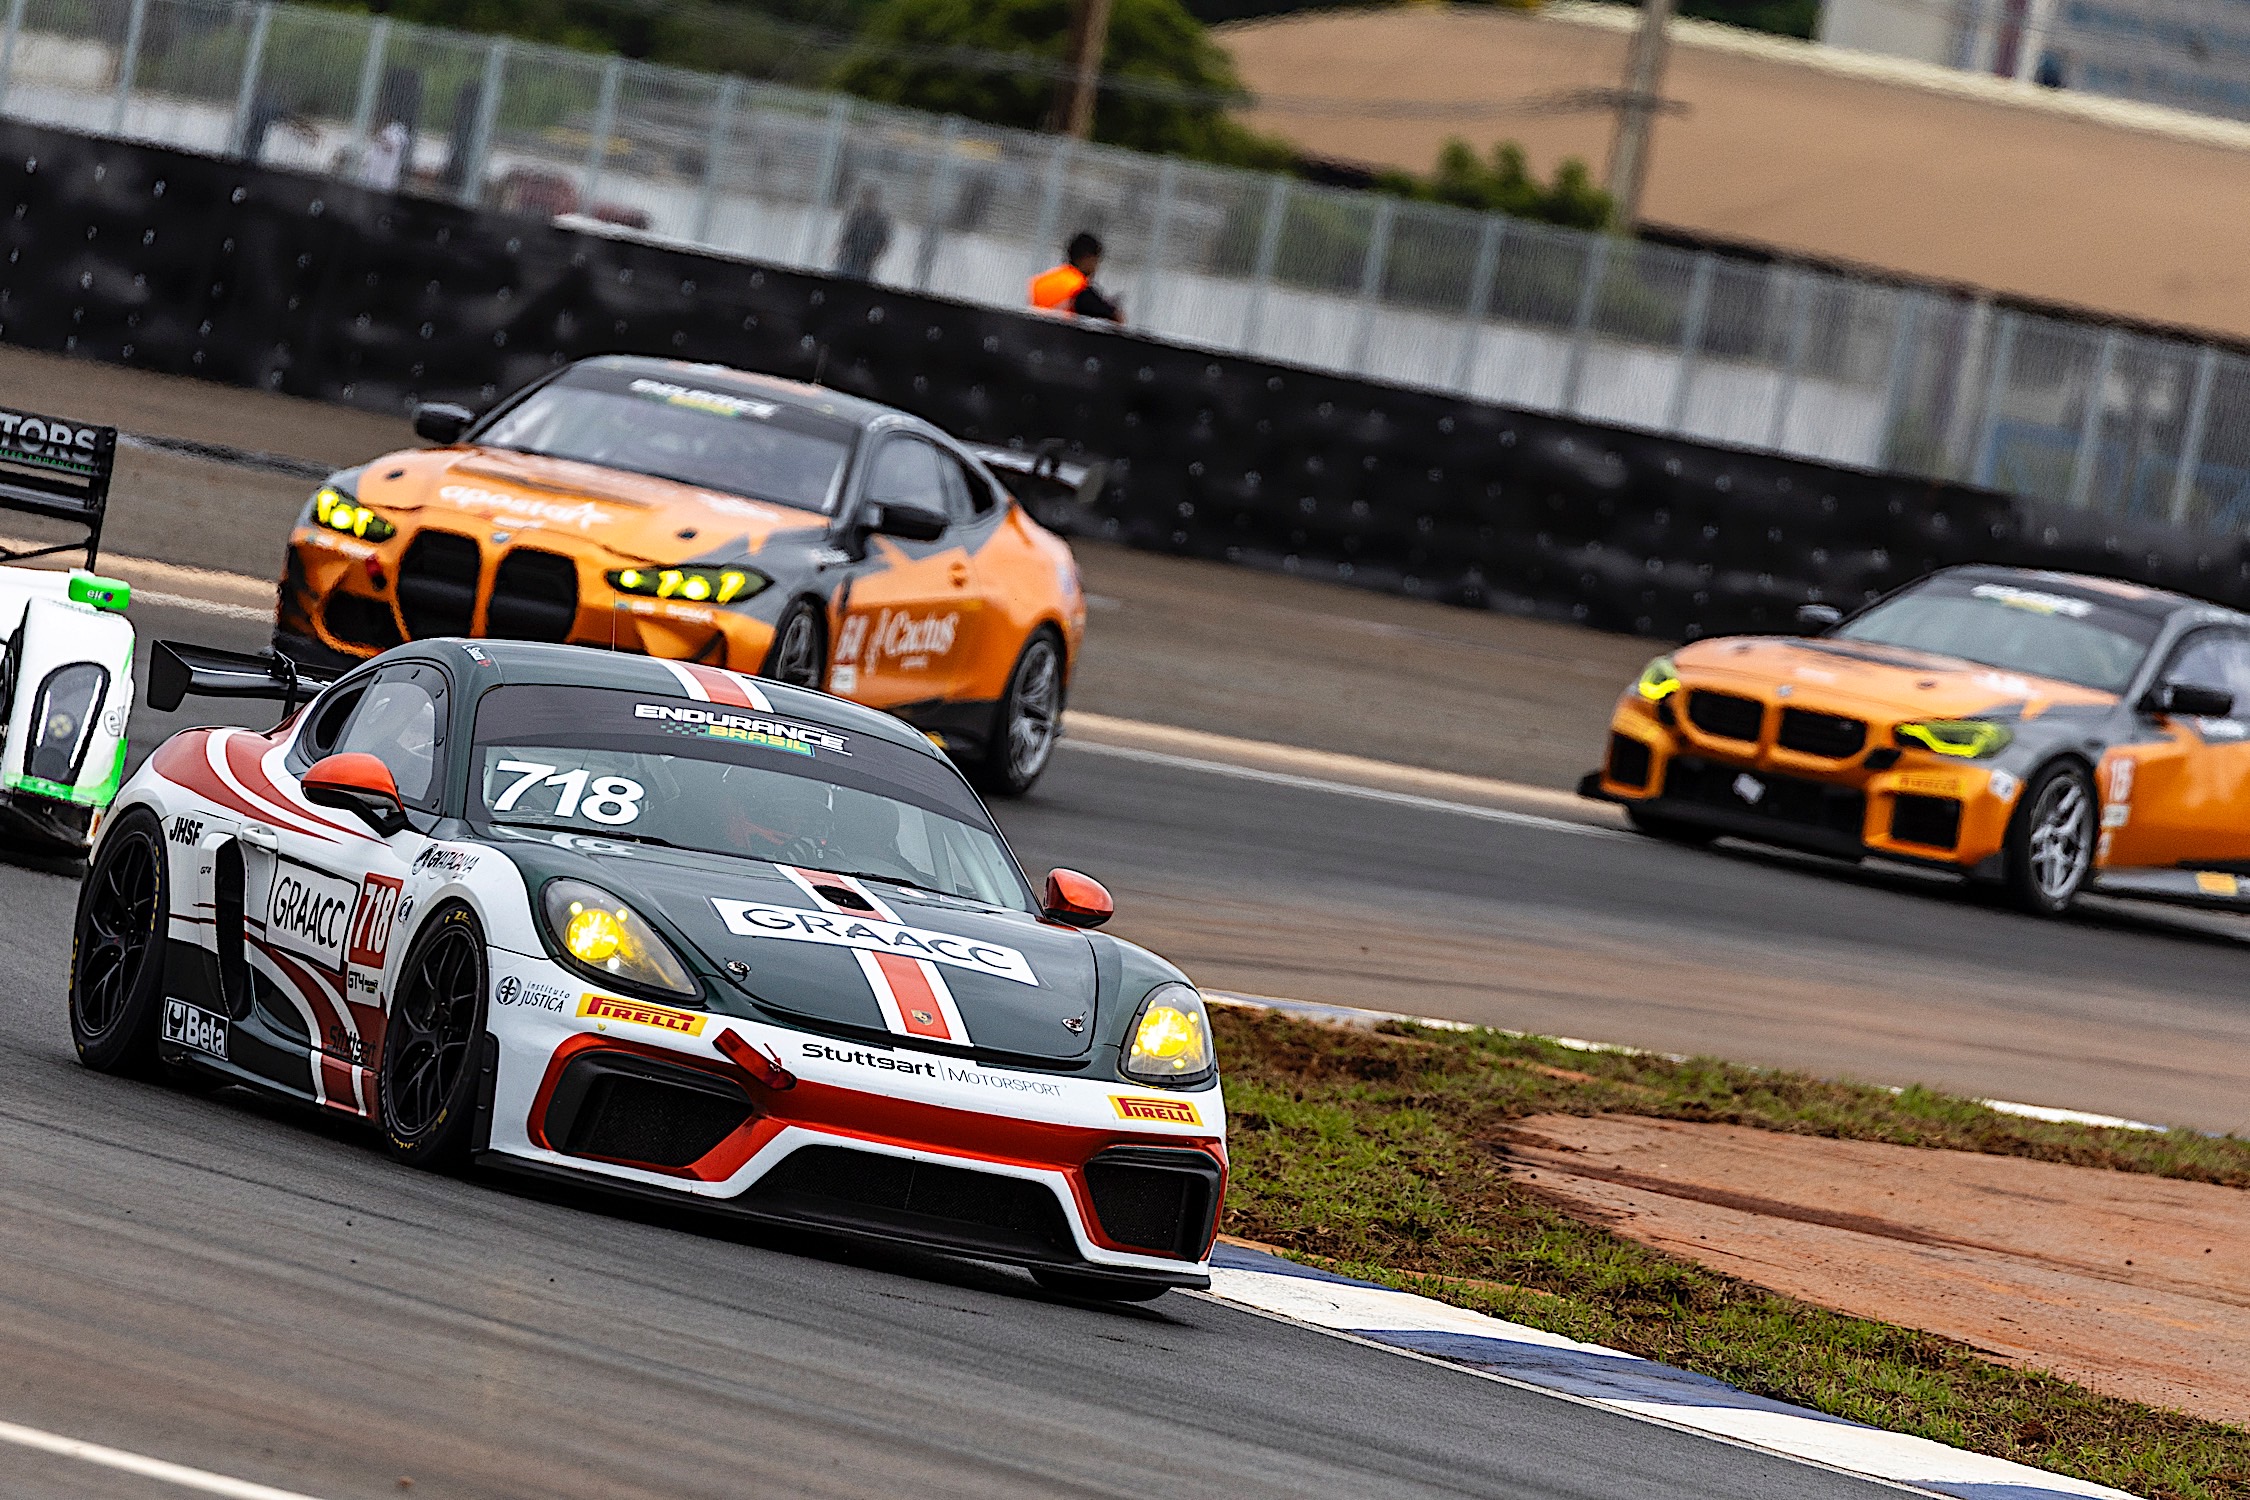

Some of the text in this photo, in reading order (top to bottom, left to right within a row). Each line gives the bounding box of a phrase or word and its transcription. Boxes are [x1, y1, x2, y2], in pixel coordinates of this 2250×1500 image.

[634, 704, 844, 751] ENDURANCE
[709, 725, 808, 752] BRASIL
[493, 759, 645, 825] 718
[169, 817, 203, 847] JHSF
[273, 876, 346, 949] GRAACC
[353, 882, 397, 954] 718
[743, 908, 1012, 970] GRAACC
[527, 981, 571, 999] instituto
[587, 996, 696, 1032] PIRELLI
[186, 1006, 226, 1057] Beta
[801, 1042, 1061, 1098] Stuttgart MOTORSPORT
[1117, 1097, 1195, 1123] PIRELLI
